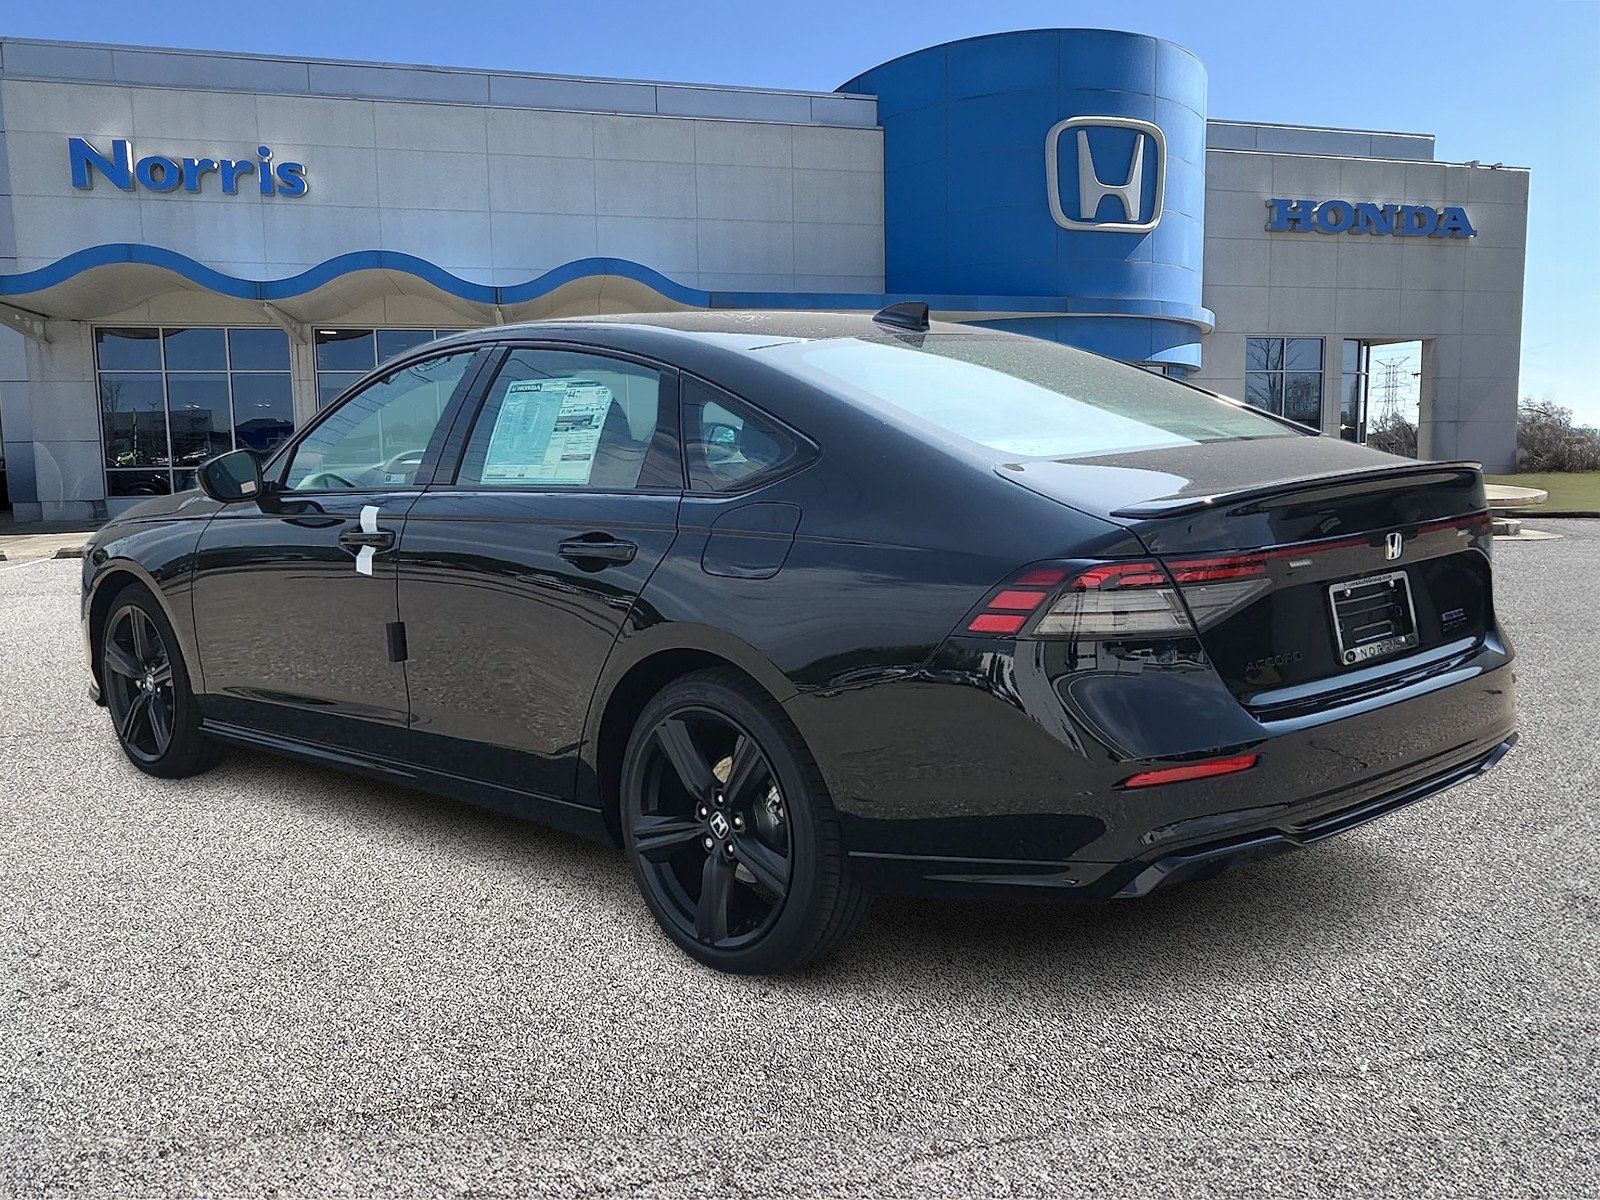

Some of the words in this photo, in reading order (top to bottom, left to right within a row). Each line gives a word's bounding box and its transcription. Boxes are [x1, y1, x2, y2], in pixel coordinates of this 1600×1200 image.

[67, 137, 309, 198] Norris
[1266, 198, 1478, 239] HONDA
[1245, 650, 1304, 673] ACCORD
